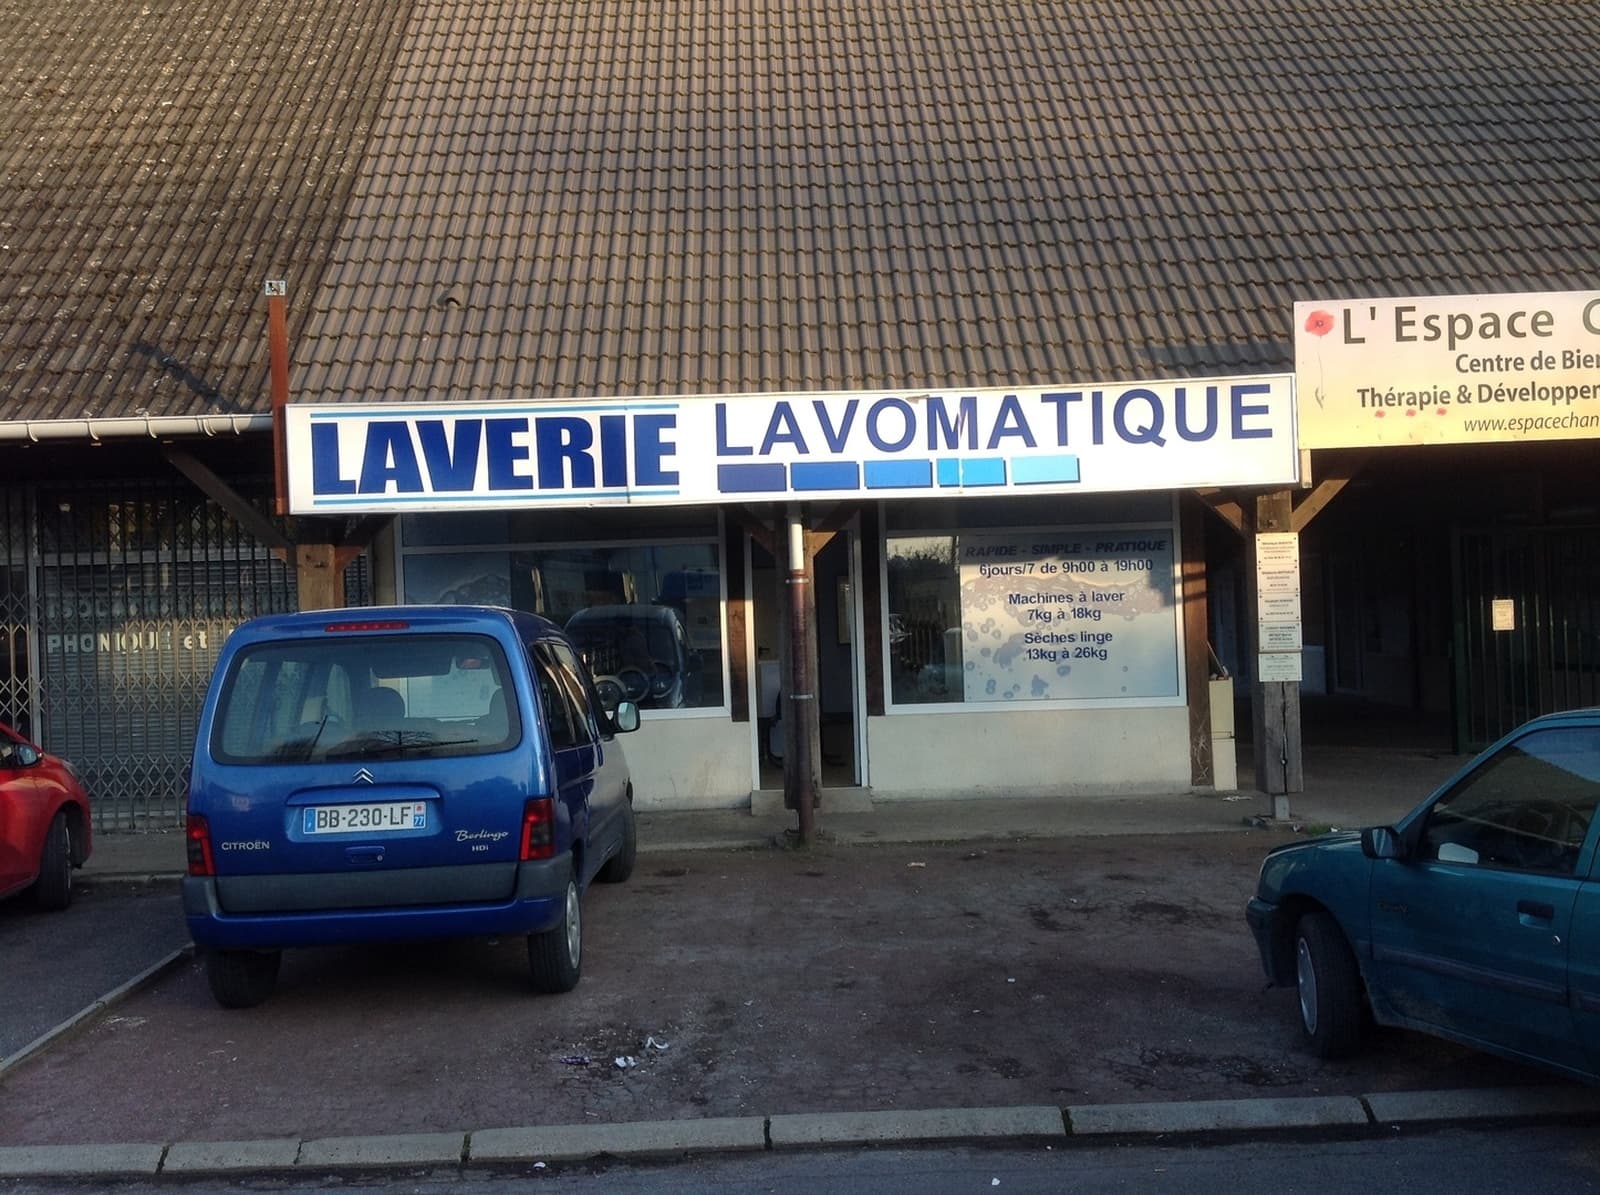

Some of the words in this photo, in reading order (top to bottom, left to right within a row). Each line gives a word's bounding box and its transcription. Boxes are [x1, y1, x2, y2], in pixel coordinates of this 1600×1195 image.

[1395, 306, 1554, 350] Espace
[1455, 354, 1525, 374] Centre
[1530, 351, 1556, 371] de
[1357, 385, 1451, 411] Thérapie
[1456, 385, 1472, 404] &
[312, 414, 679, 496] LAVERIE
[715, 384, 1273, 457] LAVOMATIQUE
[965, 545, 1018, 558] RAPIDE
[1031, 543, 1082, 556] SIMPLE
[1095, 540, 1167, 554] PRATIQUE
[979, 562, 1035, 579] 6jours/7
[1040, 562, 1058, 574] de
[1062, 561, 1095, 574] 9h00
[1100, 562, 1109, 572] à
[1114, 559, 1154, 572] 19h00
[1008, 593, 1074, 605] Machines
[1078, 592, 1087, 603] à
[1091, 591, 1126, 602] laver
[1027, 609, 1052, 623] 7kg
[1057, 609, 1066, 620] à
[1070, 607, 1101, 621] 18kg
[183, 631, 208, 650] et
[1024, 631, 1076, 645] Sèches
[1080, 631, 1113, 645] linge
[1026, 648, 1057, 662] 13kg
[1061, 648, 1070, 659] à
[1074, 647, 1108, 661] 26kg
[316, 806, 412, 829] BB-230-LF
[454, 829, 509, 842] Berlingo
[221, 840, 271, 851] CITROËN
